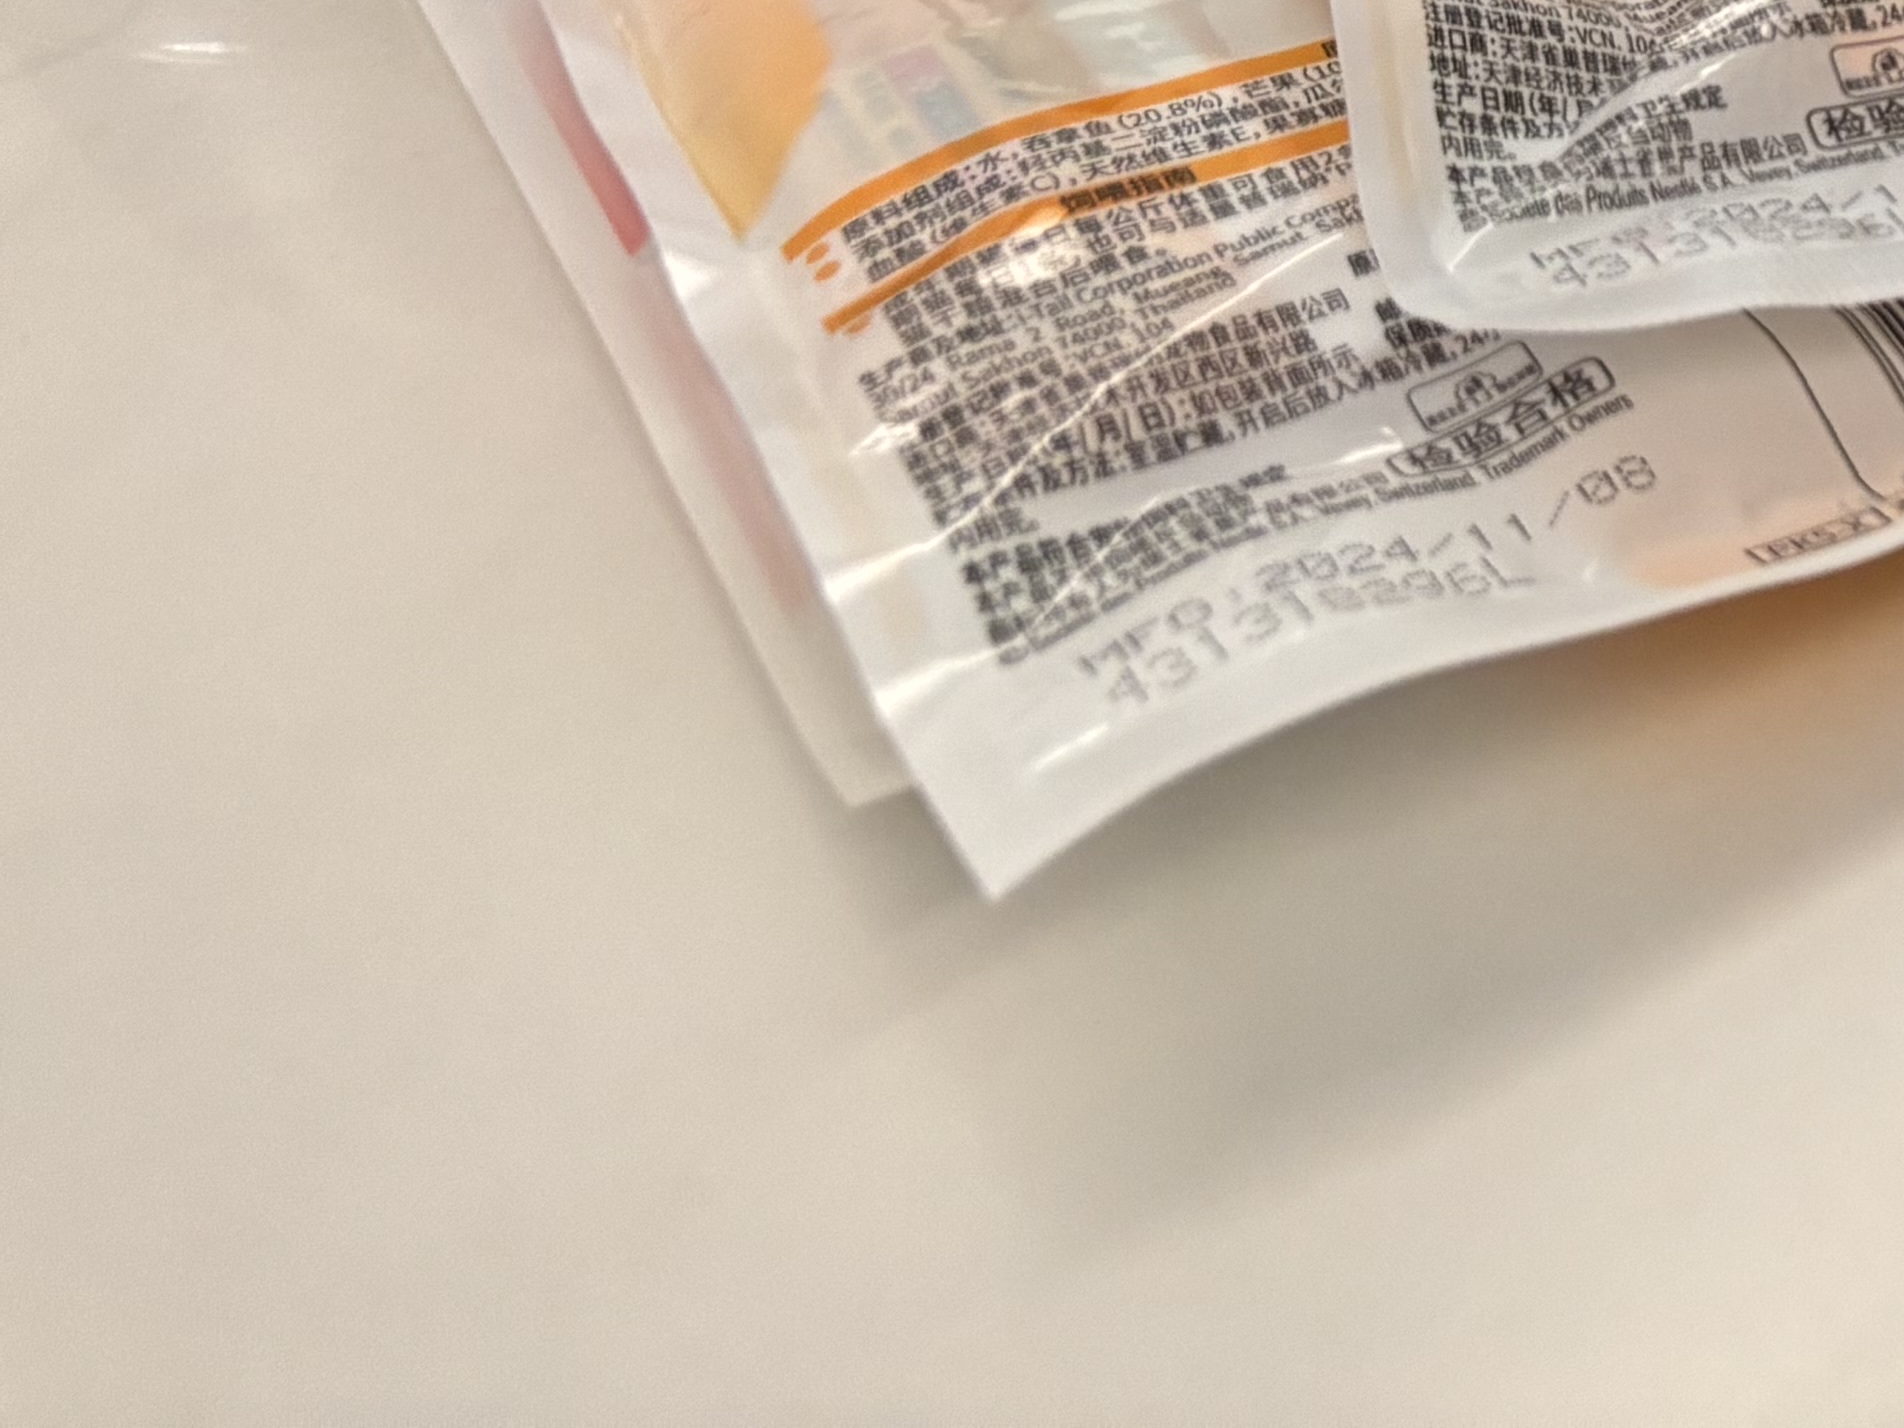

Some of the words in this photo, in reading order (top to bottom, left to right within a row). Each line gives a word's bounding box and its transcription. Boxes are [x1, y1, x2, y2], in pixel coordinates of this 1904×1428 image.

[1058, 164, 1195, 216] 饲喂指南
[1215, 219, 1284, 259] Public
[1406, 365, 1599, 477] 检验合格
[1566, 390, 1635, 432] Owners
